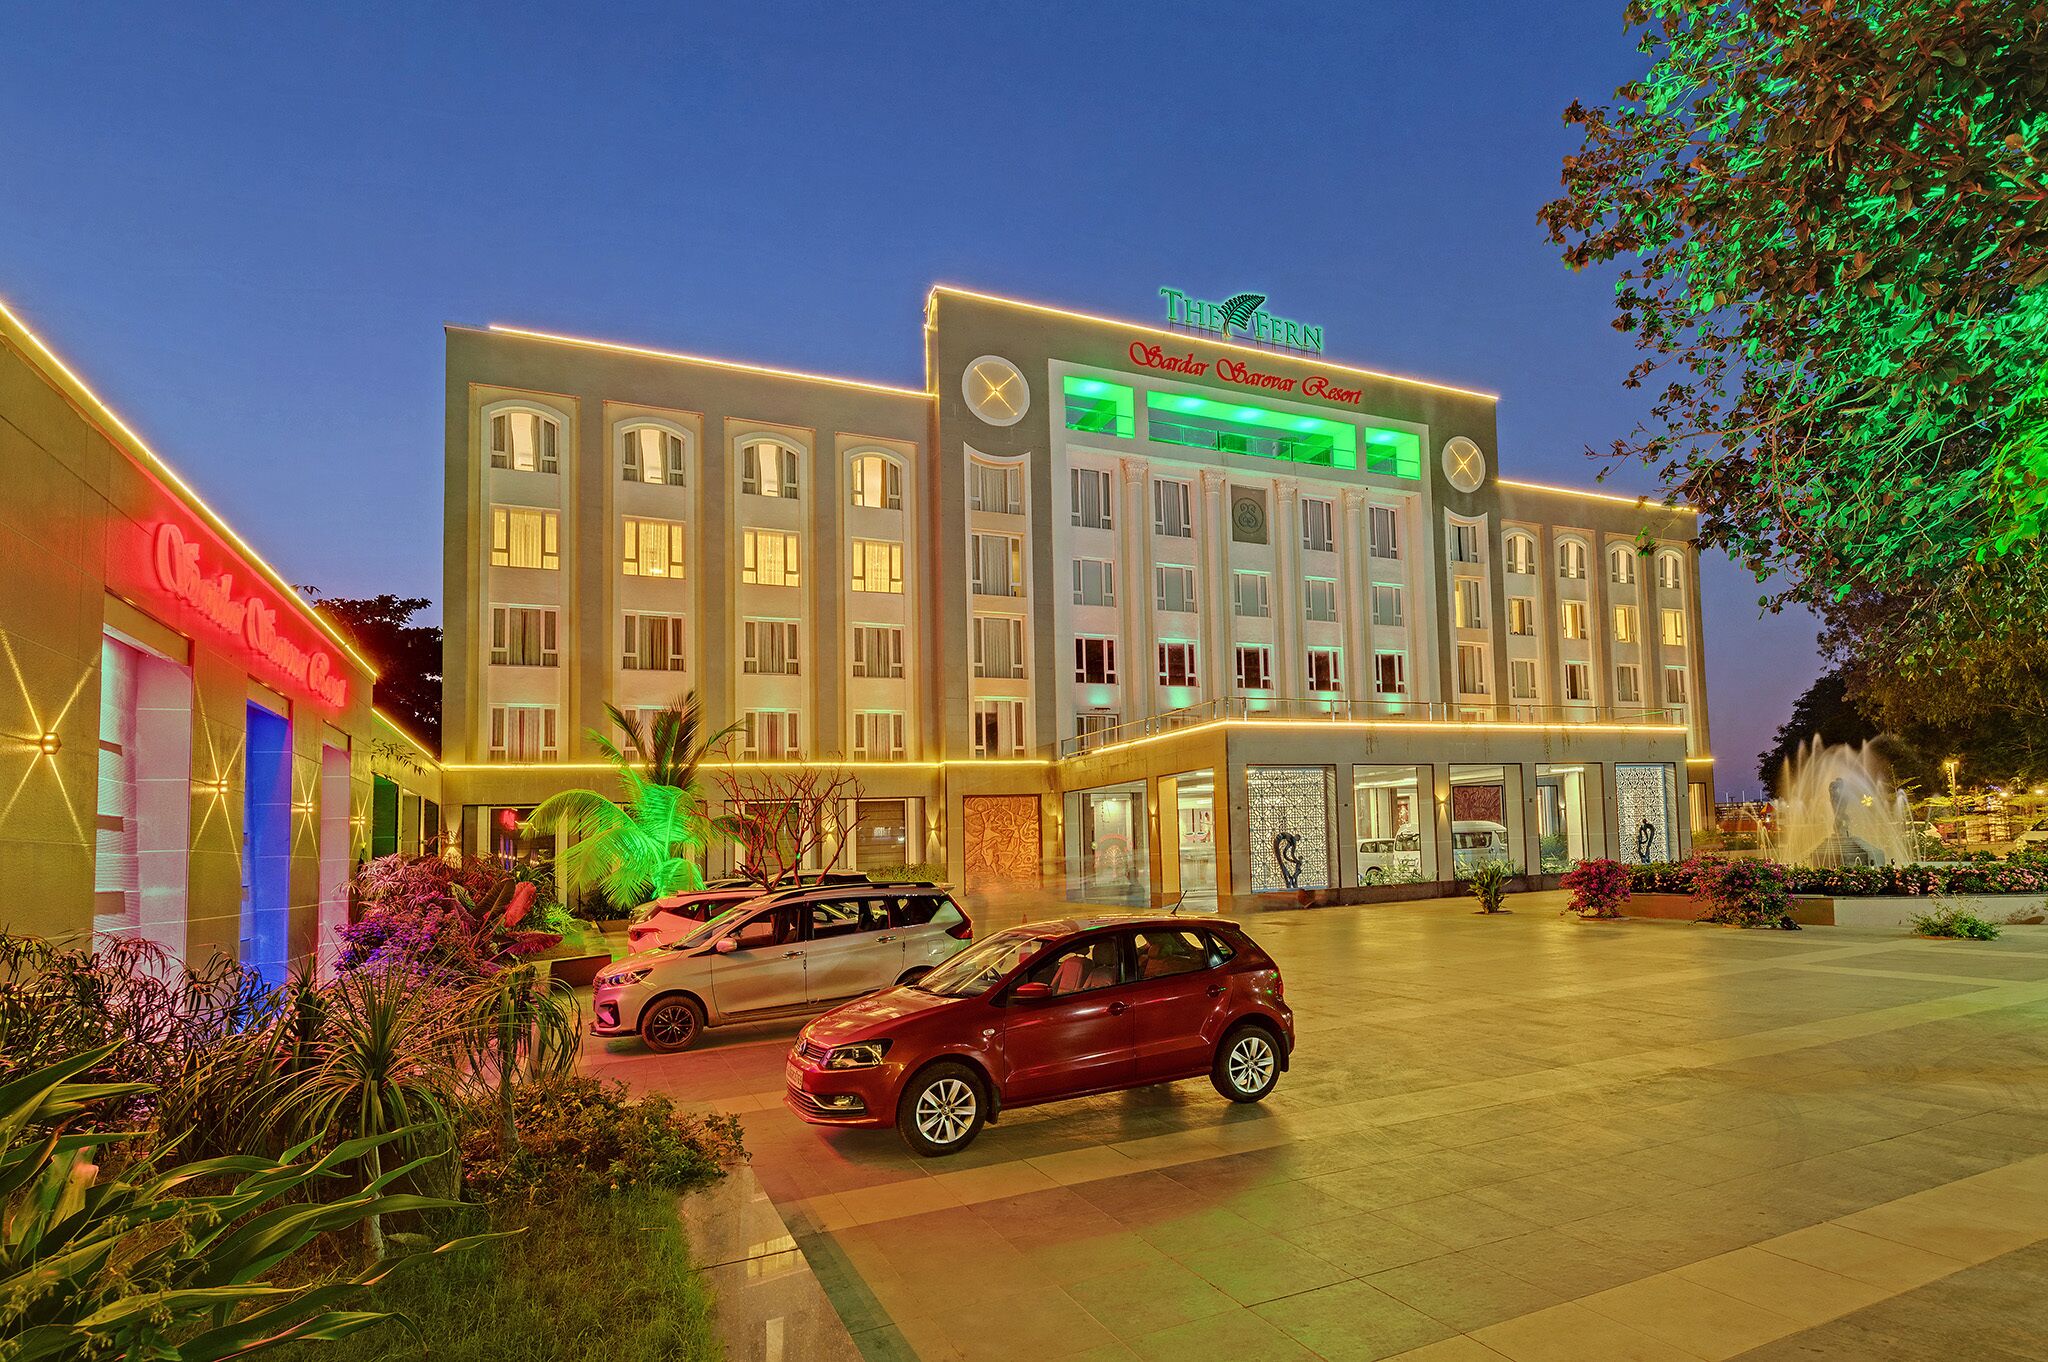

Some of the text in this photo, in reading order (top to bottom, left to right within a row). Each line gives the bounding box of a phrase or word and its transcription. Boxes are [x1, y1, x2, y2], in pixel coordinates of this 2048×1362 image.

[1161, 288, 1322, 349] THE FERN
[1129, 342, 1361, 405] Sardar Sarovar Resort
